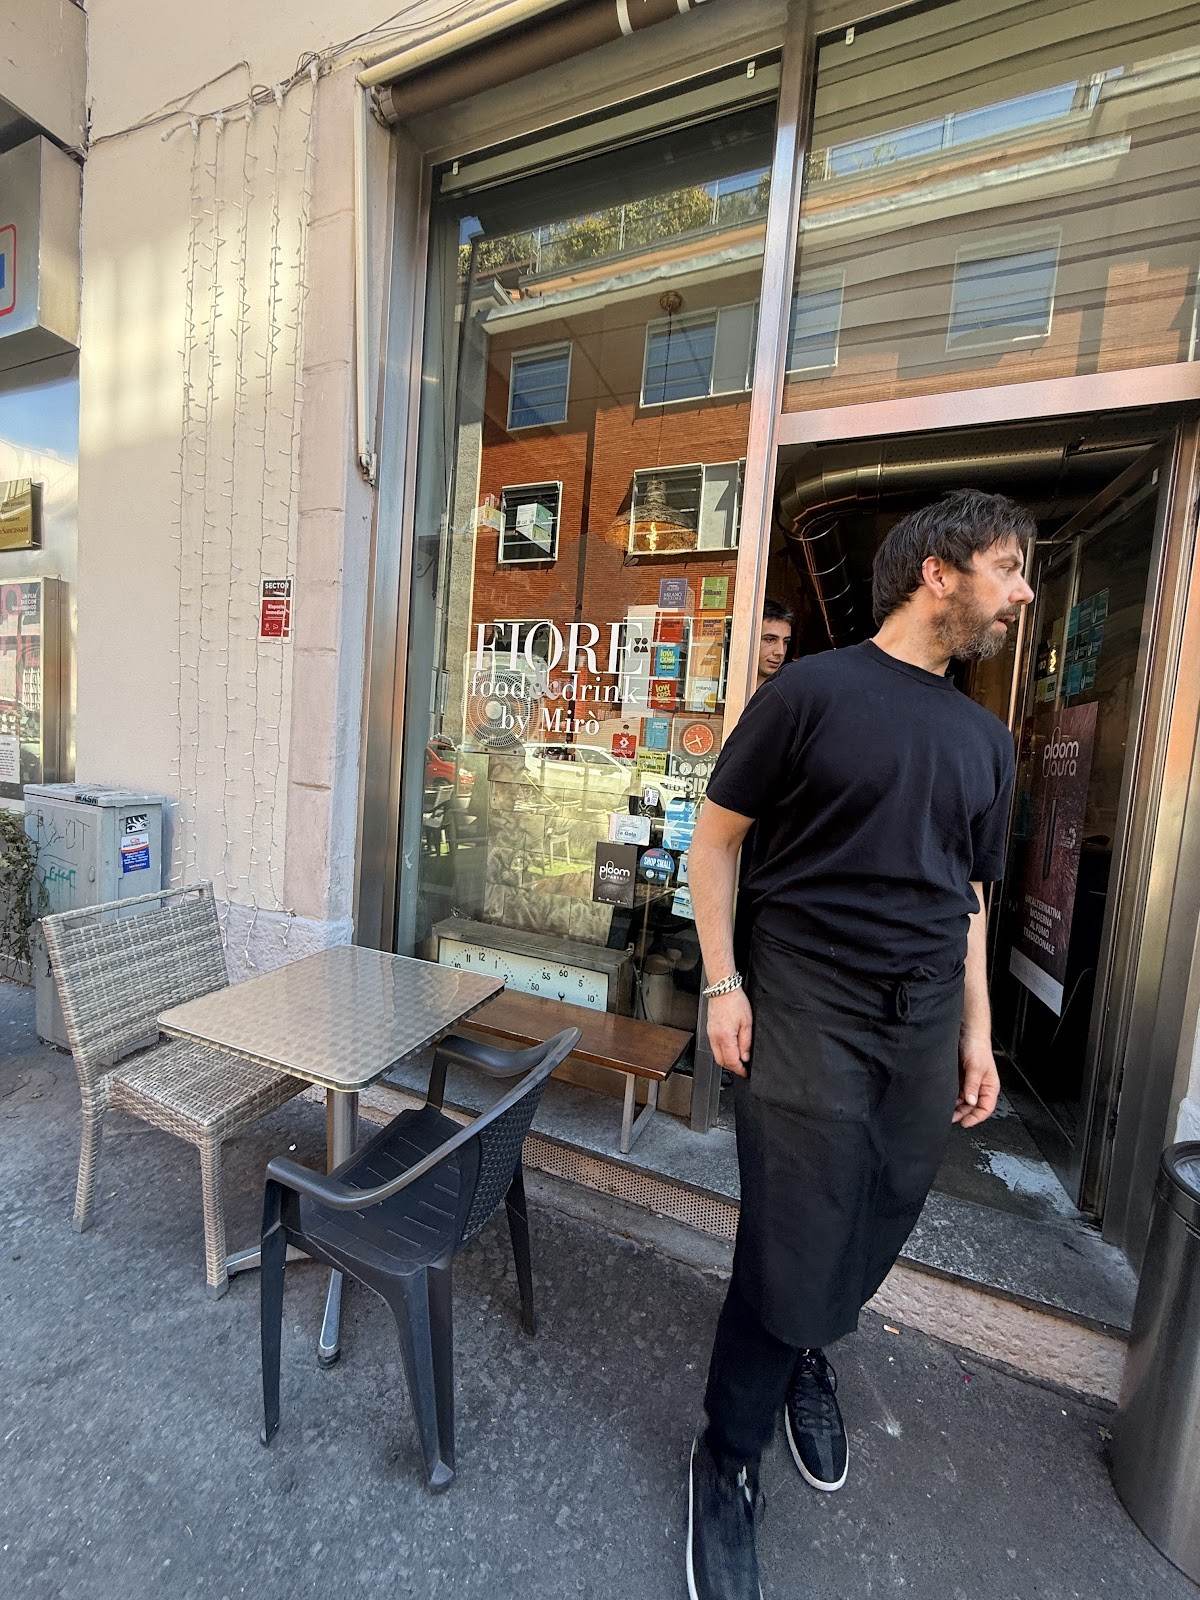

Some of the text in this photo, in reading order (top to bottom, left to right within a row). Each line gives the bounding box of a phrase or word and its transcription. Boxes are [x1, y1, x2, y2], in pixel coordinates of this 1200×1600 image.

[472, 622, 643, 675] FIORE
[470, 671, 526, 699] food
[562, 673, 641, 704] drink
[655, 683, 670, 691] low
[500, 705, 600, 738] by Mirò
[1043, 727, 1079, 777] ploom
[1051, 759, 1077, 776] aura
[672, 776, 708, 793] INSID
[600, 860, 630, 880] ploom
[466, 954, 471, 963] 11
[478, 952, 486, 962] 12
[494, 960, 498, 969] 1
[541, 972, 551, 980] 55
[559, 969, 568, 978] 60
[503, 974, 509, 984] 2
[578, 979, 583, 988] 5
[530, 982, 540, 991] 50
[587, 994, 595, 1003] 10
